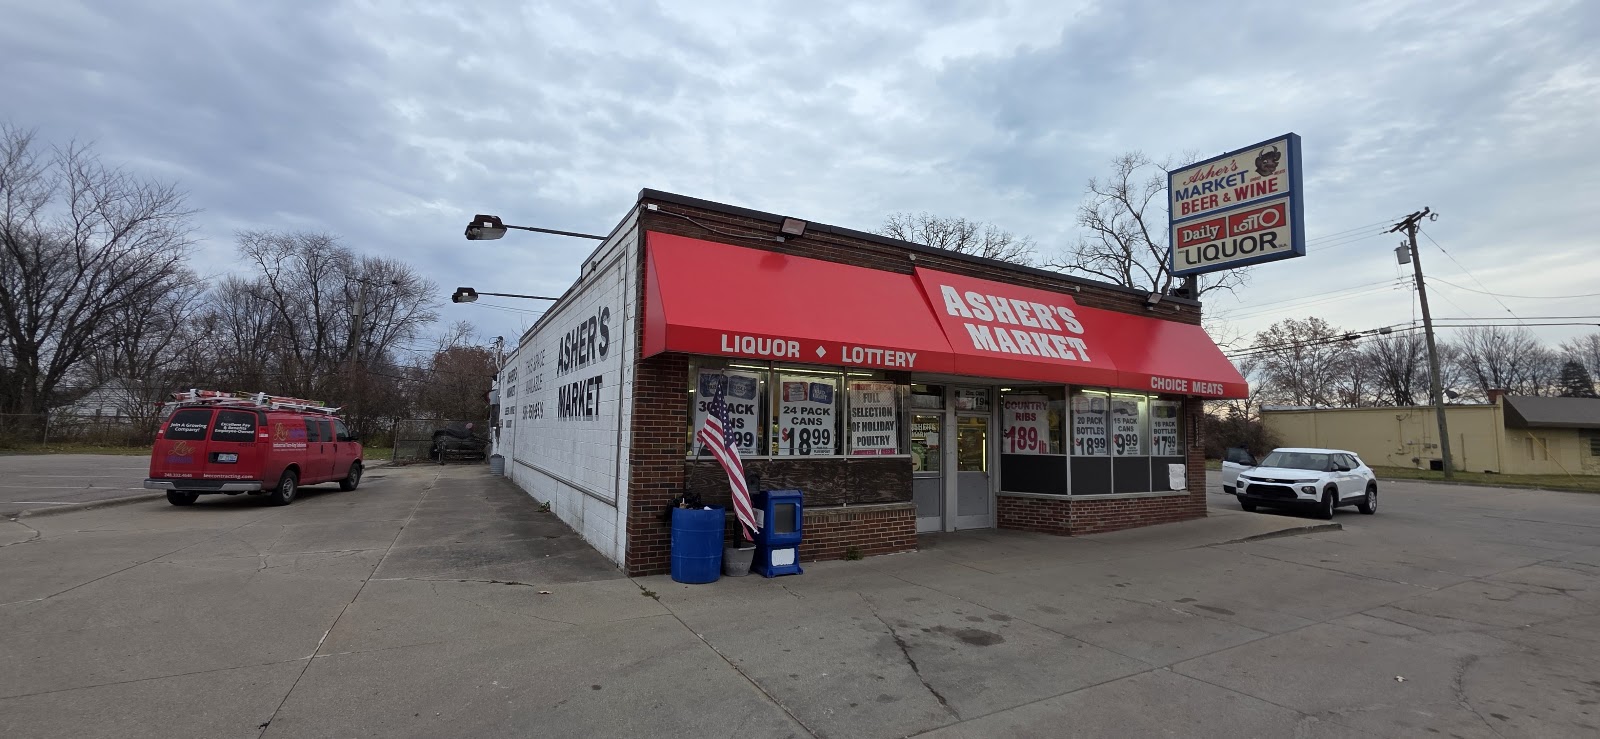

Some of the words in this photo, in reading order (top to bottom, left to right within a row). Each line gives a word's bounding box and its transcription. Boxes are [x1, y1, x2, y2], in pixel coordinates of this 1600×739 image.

[1183, 159, 1238, 186] Asher's
[1175, 170, 1249, 202] MARKET
[1182, 194, 1219, 215] BEER
[1223, 193, 1231, 202] &
[1234, 177, 1278, 201] WINE
[1182, 224, 1220, 244] Daily
[1185, 231, 1277, 265] LIQUOR
[940, 285, 1084, 334] ASHER'S
[557, 306, 611, 376] ASHER'S
[721, 334, 800, 358] LIQUOR
[964, 323, 1091, 362] MARKET
[842, 346, 917, 368] LOTTERY
[1151, 376, 1187, 392] CHOICE
[1192, 381, 1223, 395] MEATS
[558, 375, 602, 420] MARKET
[863, 393, 880, 403] FULL
[1005, 401, 1047, 410] COUNTRY
[725, 403, 754, 415] ACK
[783, 406, 797, 414] 24
[801, 407, 830, 416] PACK
[852, 407, 893, 417] SELECTION
[1016, 413, 1036, 421] RIBS
[791, 417, 823, 426] CANS
[852, 422, 861, 432] OF
[862, 421, 894, 432] HOLIDAY
[1076, 427, 1104, 435] BOTTLES
[857, 435, 890, 446] POULTRY
